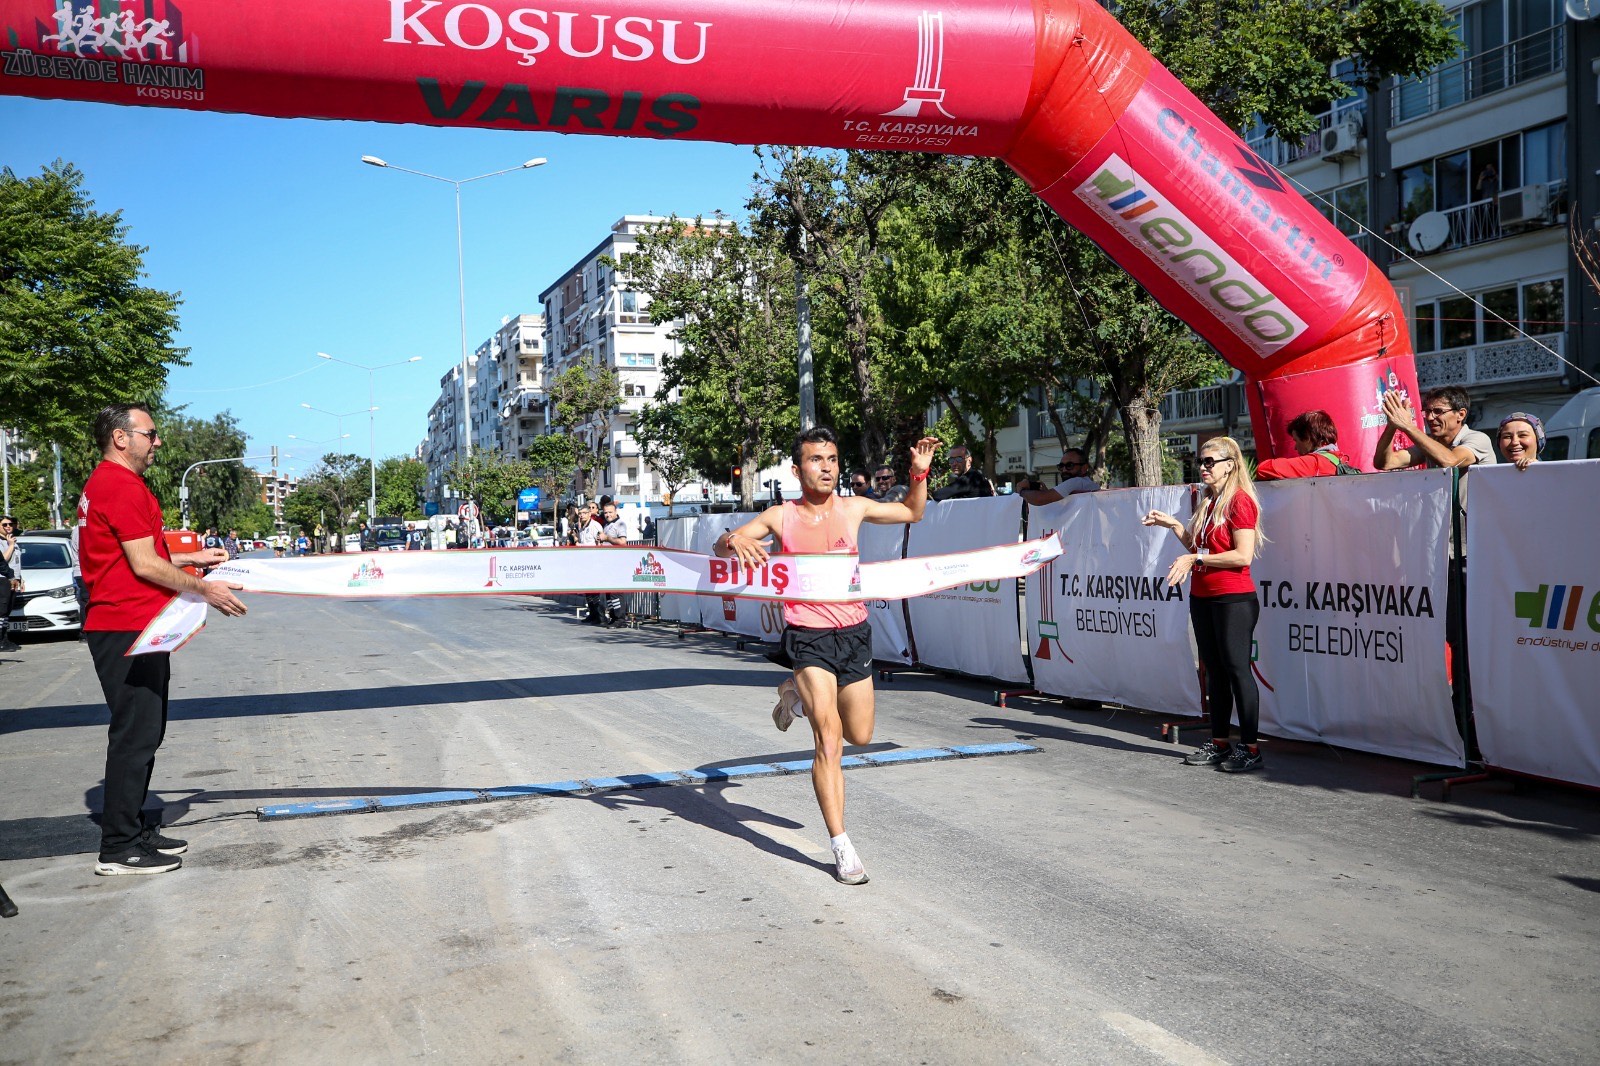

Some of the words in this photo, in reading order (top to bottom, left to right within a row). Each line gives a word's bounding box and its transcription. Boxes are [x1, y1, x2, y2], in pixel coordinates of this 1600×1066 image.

[382, 0, 713, 66] KOŞUSU
[2, 49, 118, 83] ZÜBEYDE
[123, 62, 204, 90] HANIM
[136, 86, 205, 101] KOŞUSU
[416, 76, 702, 137] VARIŞ
[843, 120, 872, 132] T.C.
[878, 122, 979, 137] KARŞIYAKA
[856, 134, 953, 147] BELEDİYESİ
[1157, 107, 1335, 281] Chamartin
[1140, 217, 1294, 342] endo
[1061, 574, 1082, 597] T.C.
[1086, 575, 1183, 603] KARŞIYAKA
[1259, 580, 1299, 610] T.C.
[1305, 582, 1435, 619] KARŞIYAKA
[1076, 606, 1156, 638] BELEDİYESİ
[1289, 622, 1404, 664] BELEDİYESİ
[1516, 636, 1588, 652] endüstriyel
